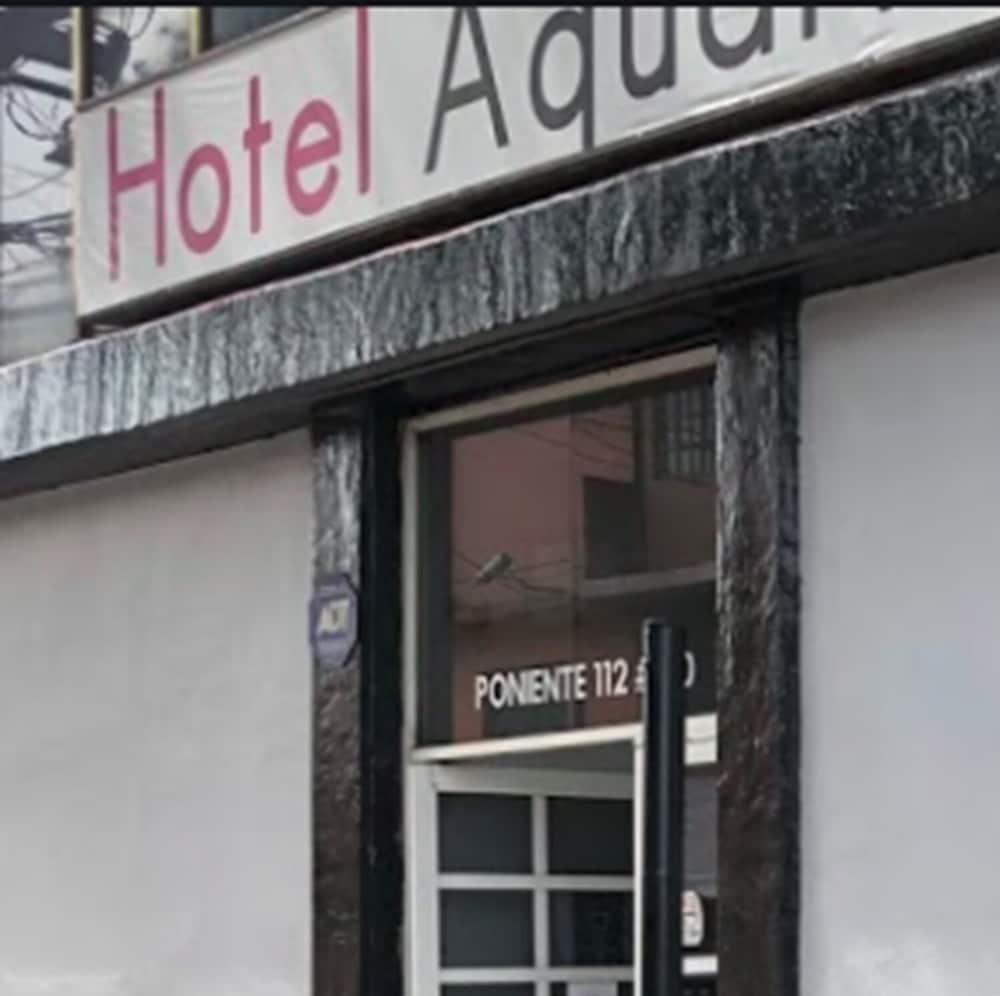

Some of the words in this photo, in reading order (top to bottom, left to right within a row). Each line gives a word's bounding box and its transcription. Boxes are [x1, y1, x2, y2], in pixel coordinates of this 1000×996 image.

[107, 8, 371, 282] Hotel
[474, 662, 587, 710] PONIENTE
[593, 658, 629, 697] 112
